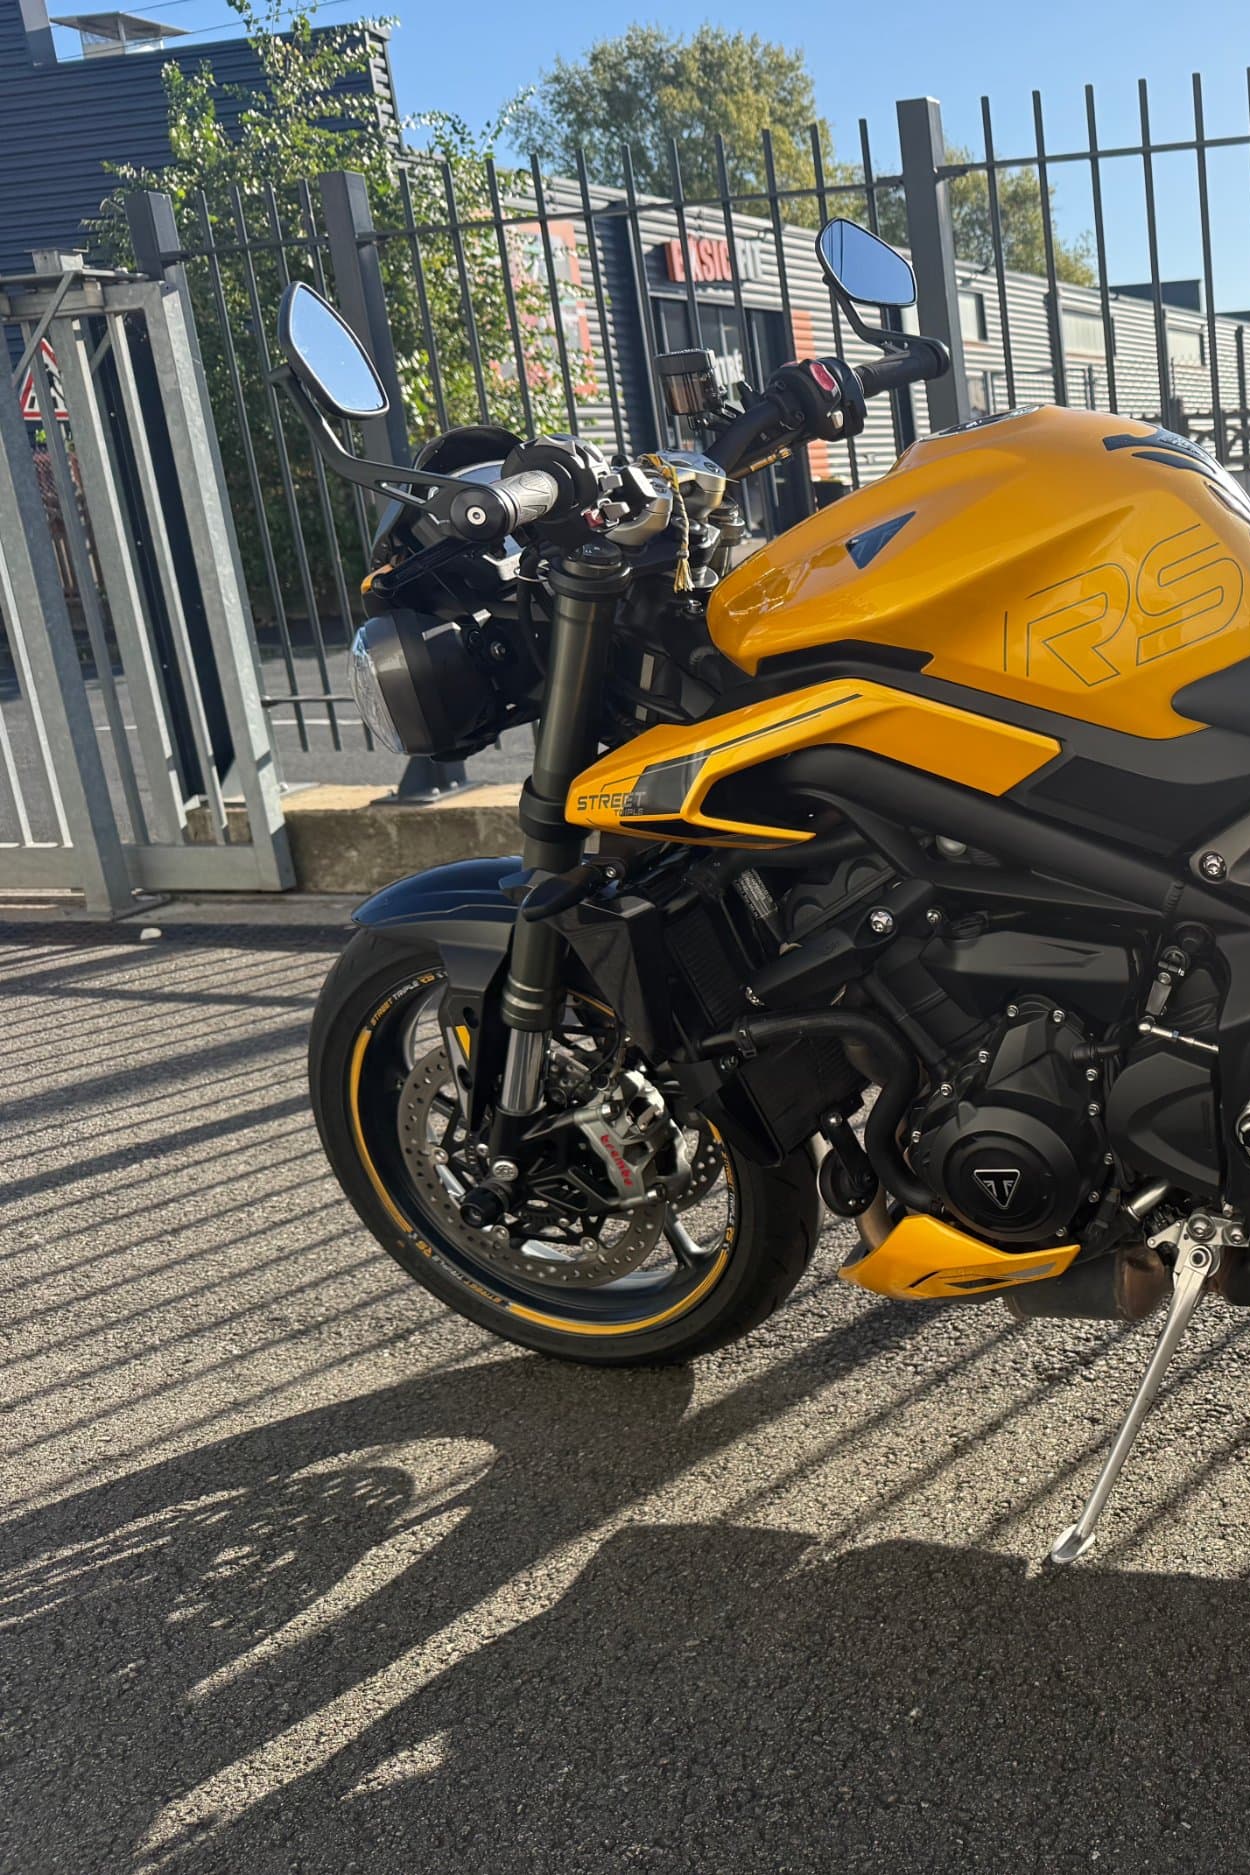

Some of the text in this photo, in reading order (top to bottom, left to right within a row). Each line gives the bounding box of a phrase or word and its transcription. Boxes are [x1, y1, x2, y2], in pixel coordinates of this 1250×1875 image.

[1003, 523, 1244, 687] RS
[577, 791, 647, 811] STREET
[601, 1134, 634, 1188] brembo
